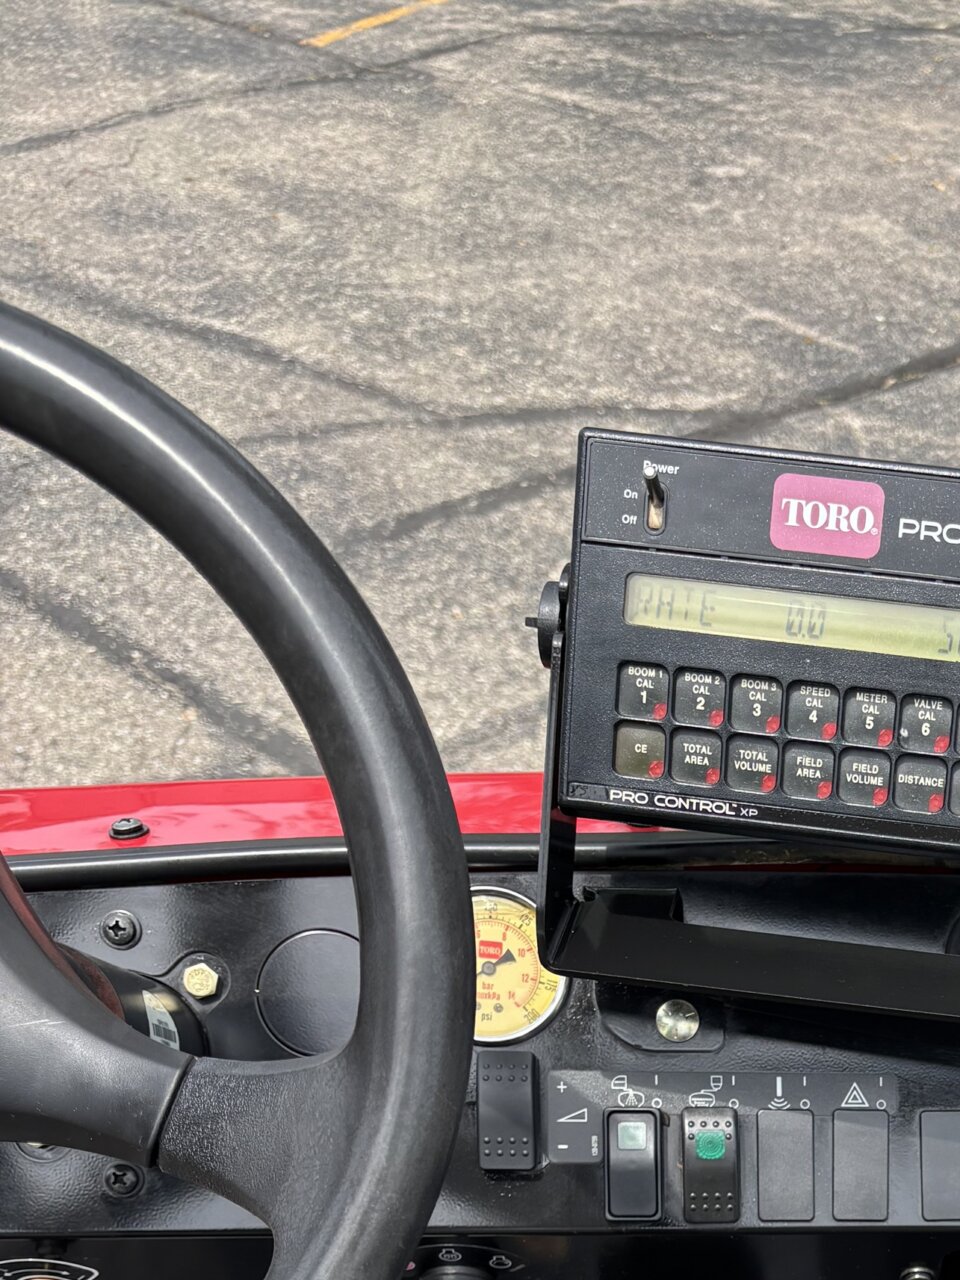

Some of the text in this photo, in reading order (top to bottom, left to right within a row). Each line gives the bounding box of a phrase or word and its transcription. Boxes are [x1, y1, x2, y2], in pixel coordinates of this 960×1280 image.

[623, 489, 638, 499] On
[621, 514, 637, 525] Off
[781, 498, 879, 535] TORO
[628, 666, 663, 678] BOOM 1
[636, 679, 654, 689] CAL
[685, 672, 720, 685] BOOM 2
[692, 685, 710, 695] CAL
[741, 679, 777, 691] BOOM 3
[640, 691, 647, 704] 1
[749, 691, 766, 702] CAL
[800, 686, 831, 698] SPEED
[805, 698, 823, 708] CAL
[856, 692, 888, 704] METER
[696, 698, 705, 710] 2
[862, 704, 880, 715] CAL
[914, 699, 943, 710] VALVE
[753, 704, 762, 717] 3
[918, 710, 936, 721] CAL
[809, 710, 818, 724] 4
[865, 717, 874, 730] 5
[921, 723, 930, 736] 6
[635, 744, 648, 754] CE
[683, 743, 712, 755] TOTAL
[684, 755, 709, 766] AREA
[739, 750, 768, 762] TOTAL
[734, 761, 772, 774] VOLUME
[797, 757, 823, 768] FIELD
[796, 768, 821, 779] AREA
[852, 763, 879, 774] FIELD
[846, 773, 884, 786] VOLUME
[898, 774, 944, 788] DISTANCE
[609, 790, 758, 817] PRO CONTROL XP
[480, 946, 500, 955] TORO
[518, 948, 526, 958] 10
[522, 973, 529, 983] 12
[482, 982, 494, 991] bar
[481, 1012, 493, 1022] psi
